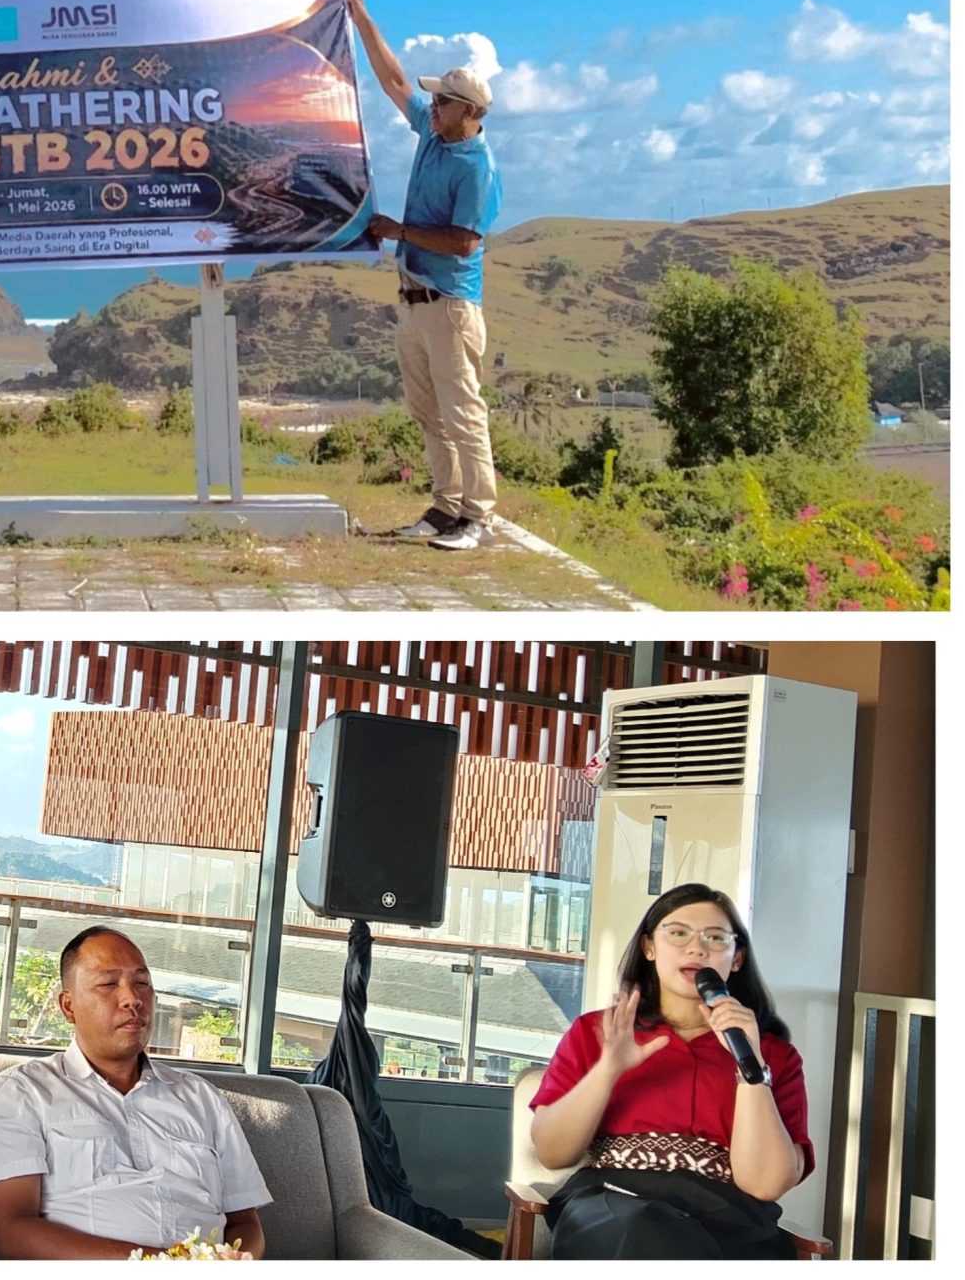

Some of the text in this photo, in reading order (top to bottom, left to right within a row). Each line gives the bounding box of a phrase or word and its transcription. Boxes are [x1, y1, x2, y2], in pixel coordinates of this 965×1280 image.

[41, 4, 117, 28] JMSI
[94, 56, 120, 86] &
[84, 127, 210, 171] 2026
[6, 187, 50, 199] Jumat,
[137, 183, 201, 195] 16.00 WITA
[8, 200, 76, 213] 1 Mei 2026
[149, 196, 191, 208] Selesai
[35, 230, 76, 241] Daerah
[79, 229, 106, 240] yang
[109, 226, 173, 238] Profesional,
[44, 241, 76, 254] Saing
[79, 241, 90, 252] di
[92, 240, 111, 252] Era
[114, 239, 150, 252] Digital
